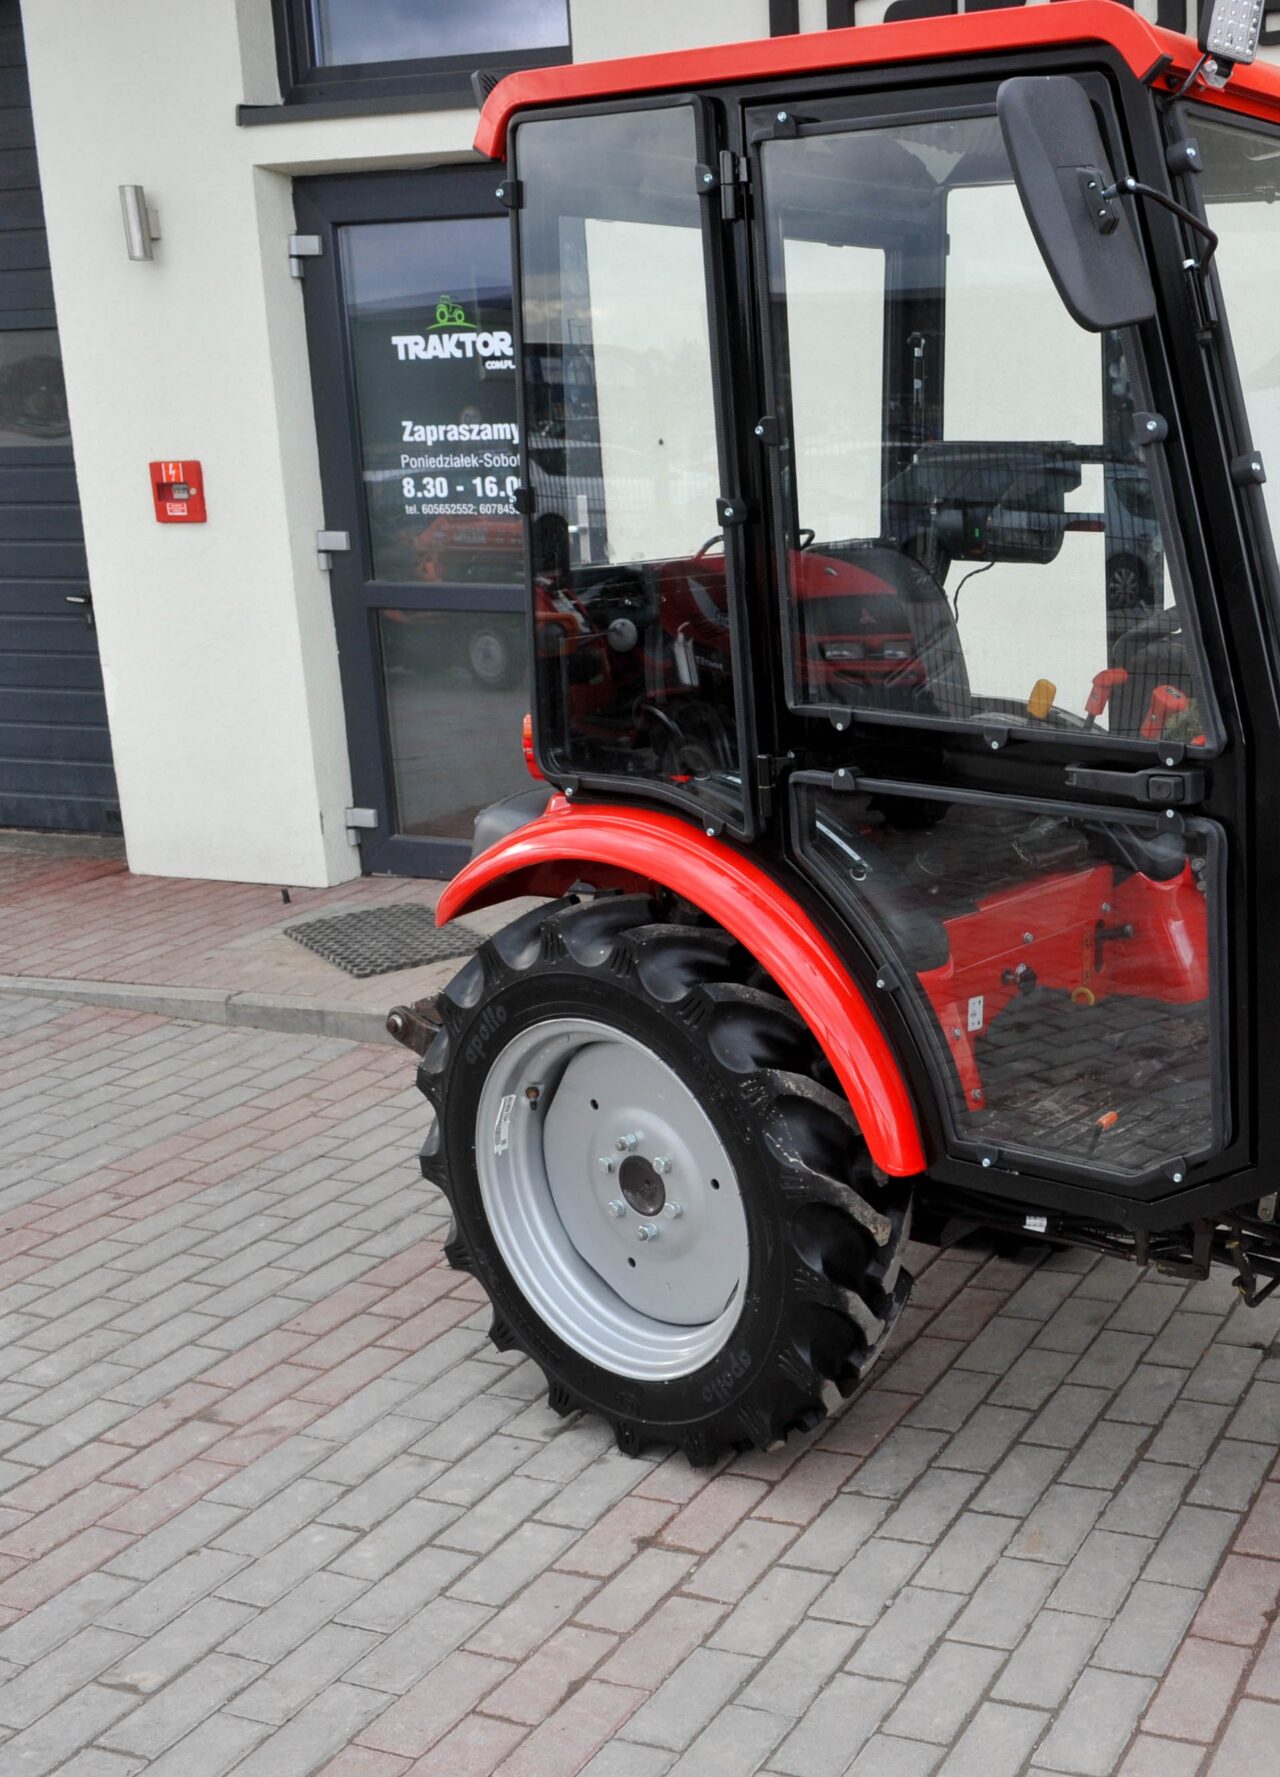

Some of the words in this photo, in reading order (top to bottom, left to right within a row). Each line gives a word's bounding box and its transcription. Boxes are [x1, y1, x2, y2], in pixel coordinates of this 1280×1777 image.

[391, 331, 514, 360] TRAKTOR
[401, 421, 519, 446] Zapraszamy
[402, 477, 448, 498] 8.30
[472, 476, 521, 498] 16.0
[405, 504, 420, 515] tel.
[479, 503, 520, 515] 607845
[465, 1004, 508, 1065] apollo
